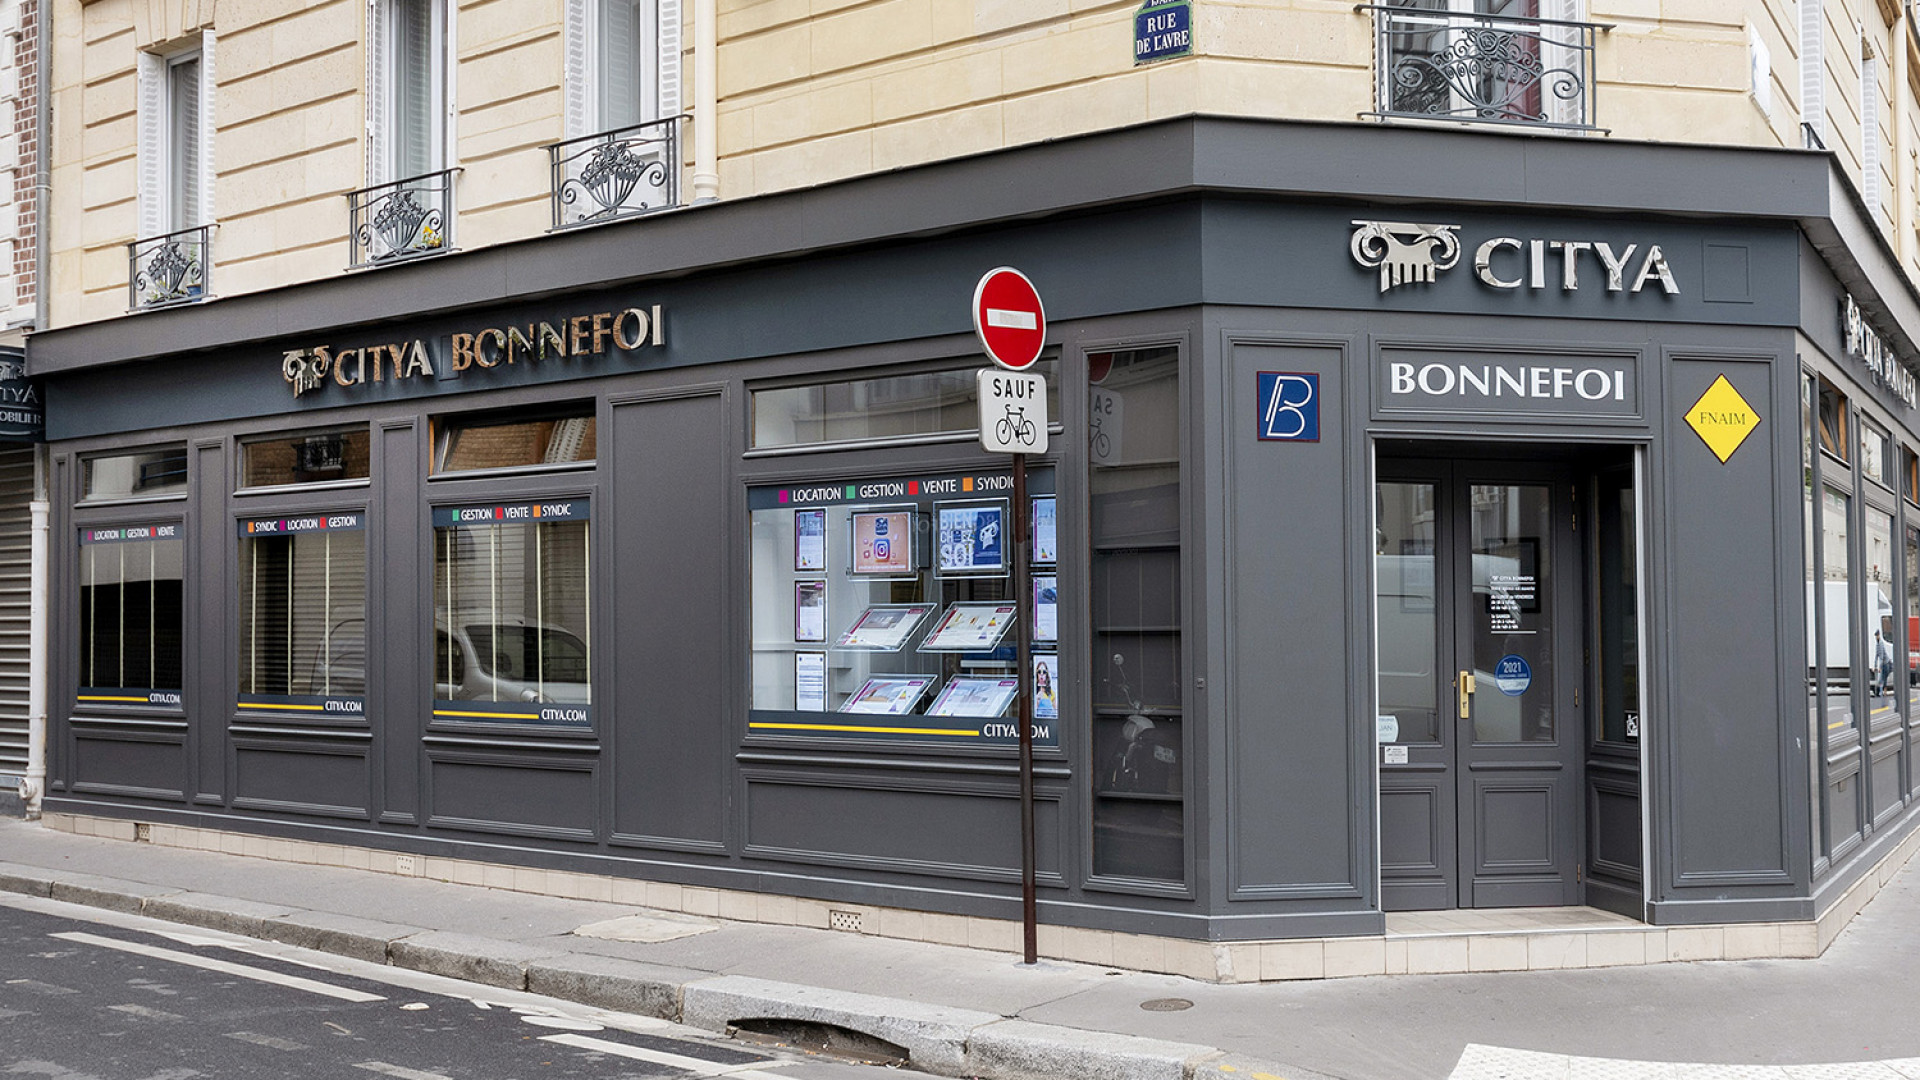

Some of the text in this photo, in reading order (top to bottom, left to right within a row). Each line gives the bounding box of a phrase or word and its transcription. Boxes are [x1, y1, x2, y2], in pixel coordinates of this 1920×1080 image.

[1147, 12, 1176, 33] RUE
[1136, 30, 1190, 55] DE L'AVRE
[1475, 237, 1680, 295] CITYA
[333, 303, 665, 386] CITYA BONNEFOI
[992, 378, 1036, 400] SAUF
[1390, 362, 1625, 401] BONNEFOI
[1700, 411, 1746, 426] FNAIM
[793, 486, 842, 502] LOCATION
[859, 483, 904, 499] GESTION
[922, 479, 957, 494] VENTE
[461, 504, 572, 521] GESTION VENTE SYNDIC
[255, 515, 357, 532] SYNDIC LOCATION GESTION
[94, 525, 175, 541] LOCATION GESTION VENTE
[1503, 661, 1522, 673] 2021
[149, 692, 181, 704] CITYA.COM
[325, 700, 363, 712] CITYA.COM
[541, 708, 587, 722] CITYA.COM
[983, 723, 1049, 739] CITYA.OM
